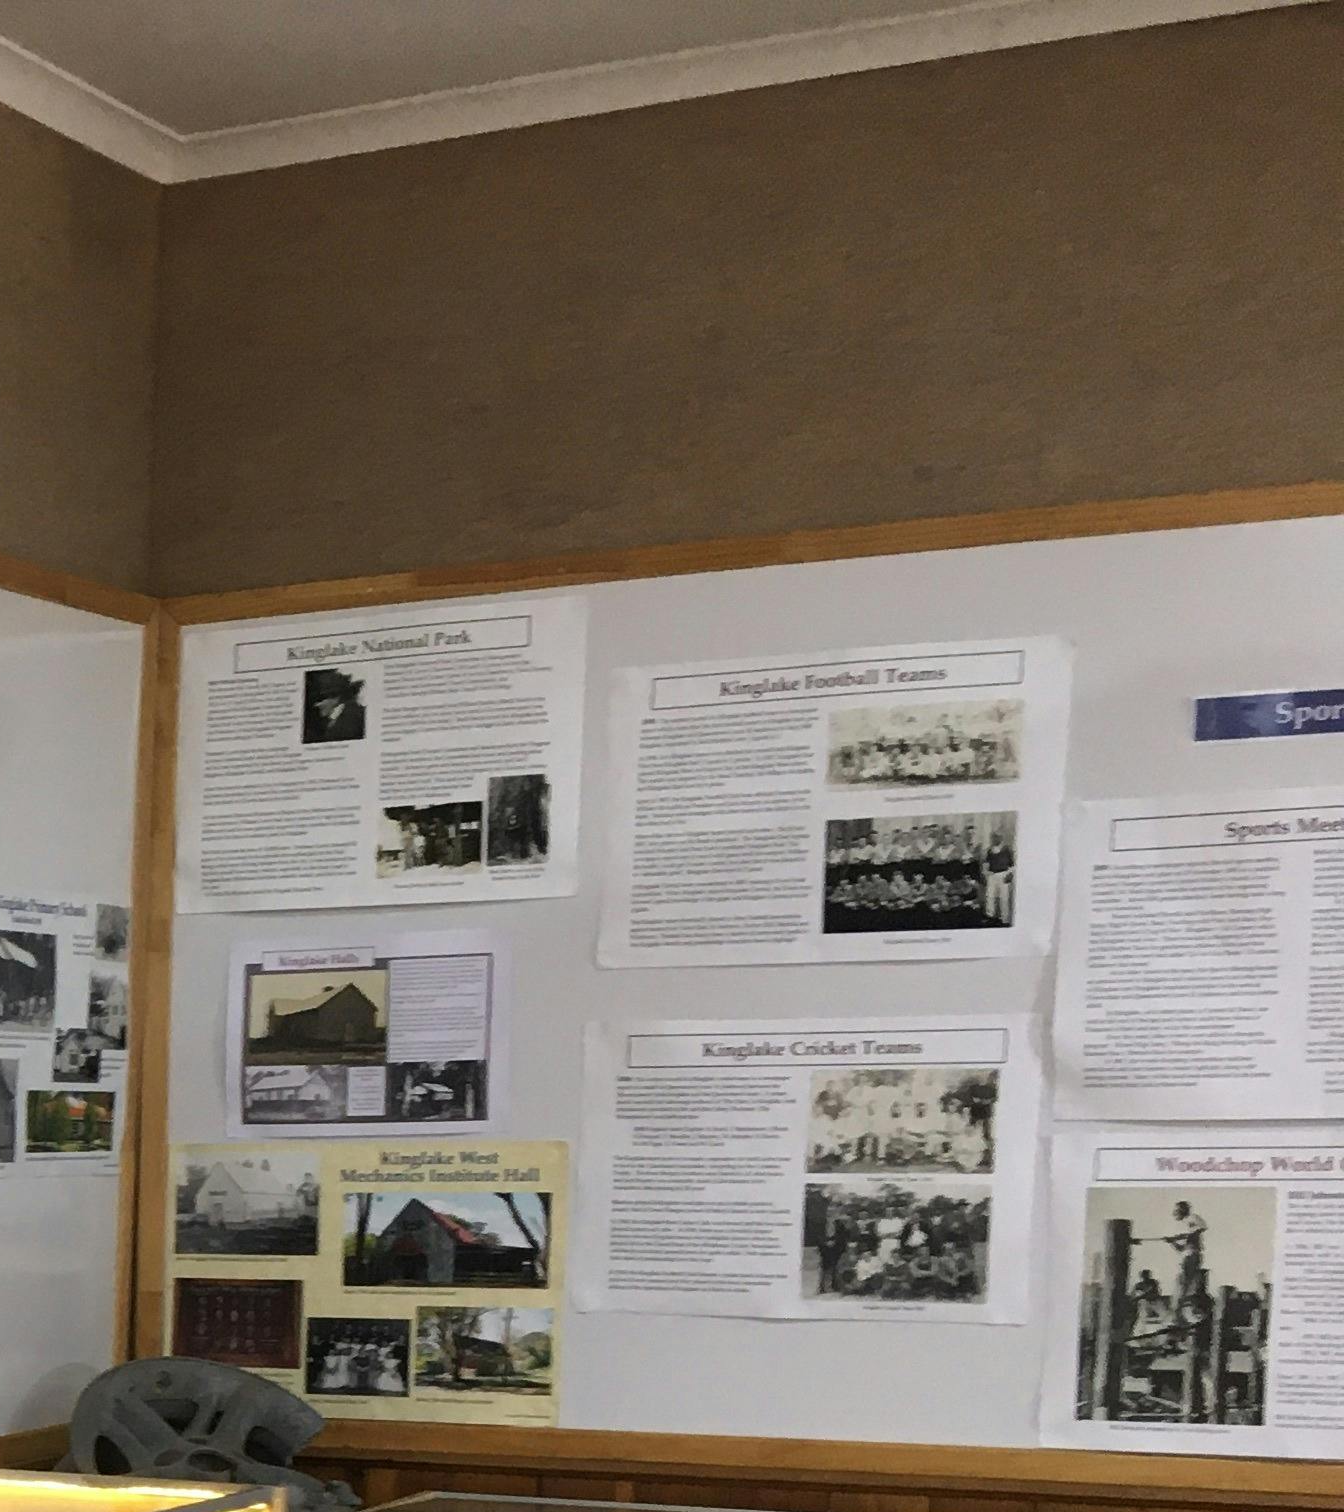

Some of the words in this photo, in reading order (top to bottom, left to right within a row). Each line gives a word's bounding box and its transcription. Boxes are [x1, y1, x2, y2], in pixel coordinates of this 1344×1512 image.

[286, 643, 358, 666] Kinglake
[361, 634, 429, 656] National
[433, 629, 473, 648] Park
[719, 677, 799, 698] Kinglake
[804, 669, 880, 690] Football
[886, 666, 948, 684] Teams
[701, 1041, 786, 1061] Kinglake
[790, 1040, 857, 1058] Cricket
[862, 1040, 923, 1056] Teams
[380, 1151, 454, 1169] Kinglake
[459, 1151, 499, 1164] West
[339, 1168, 425, 1182] Mechanics
[429, 1168, 499, 1182] Institute
[502, 1168, 540, 1182] Hall
